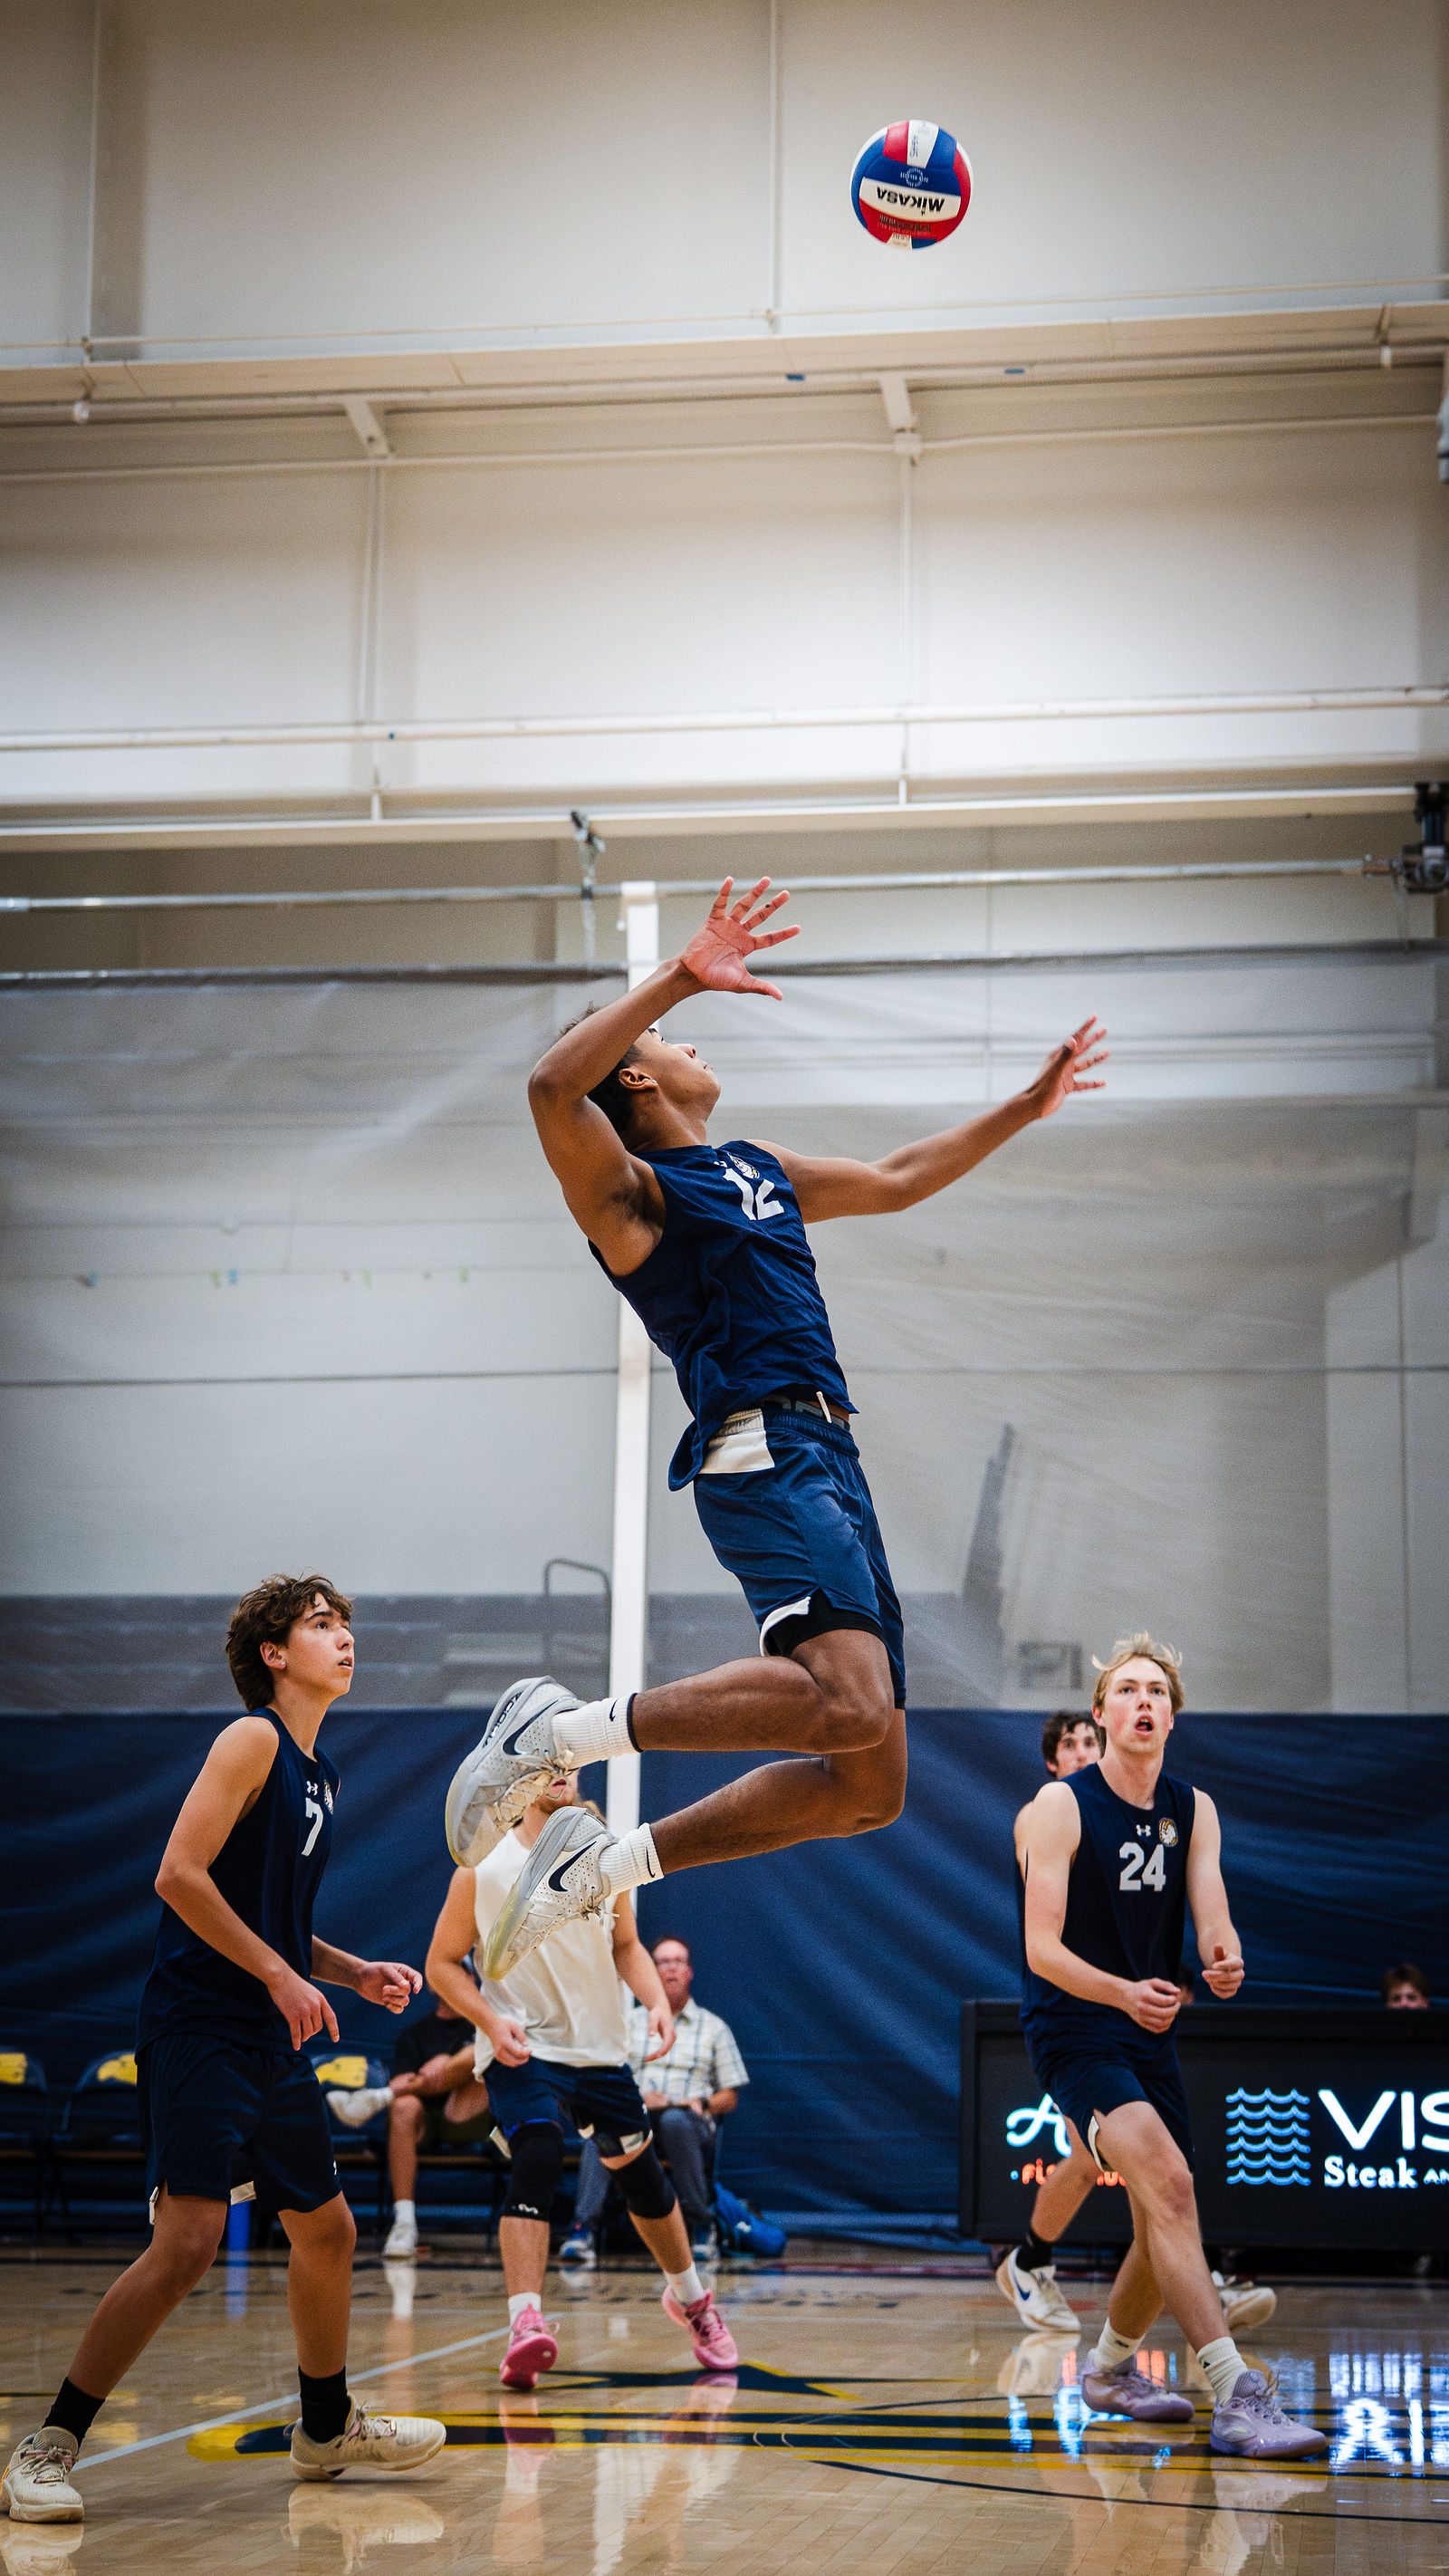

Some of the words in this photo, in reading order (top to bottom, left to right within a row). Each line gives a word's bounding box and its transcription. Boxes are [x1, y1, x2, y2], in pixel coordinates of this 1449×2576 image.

[876, 187, 945, 216] MIKASA
[722, 1168, 785, 1221] 12
[302, 1797, 323, 1857] 7
[1118, 1841, 1166, 1892] 24
[1324, 2155, 1418, 2188] Steak
